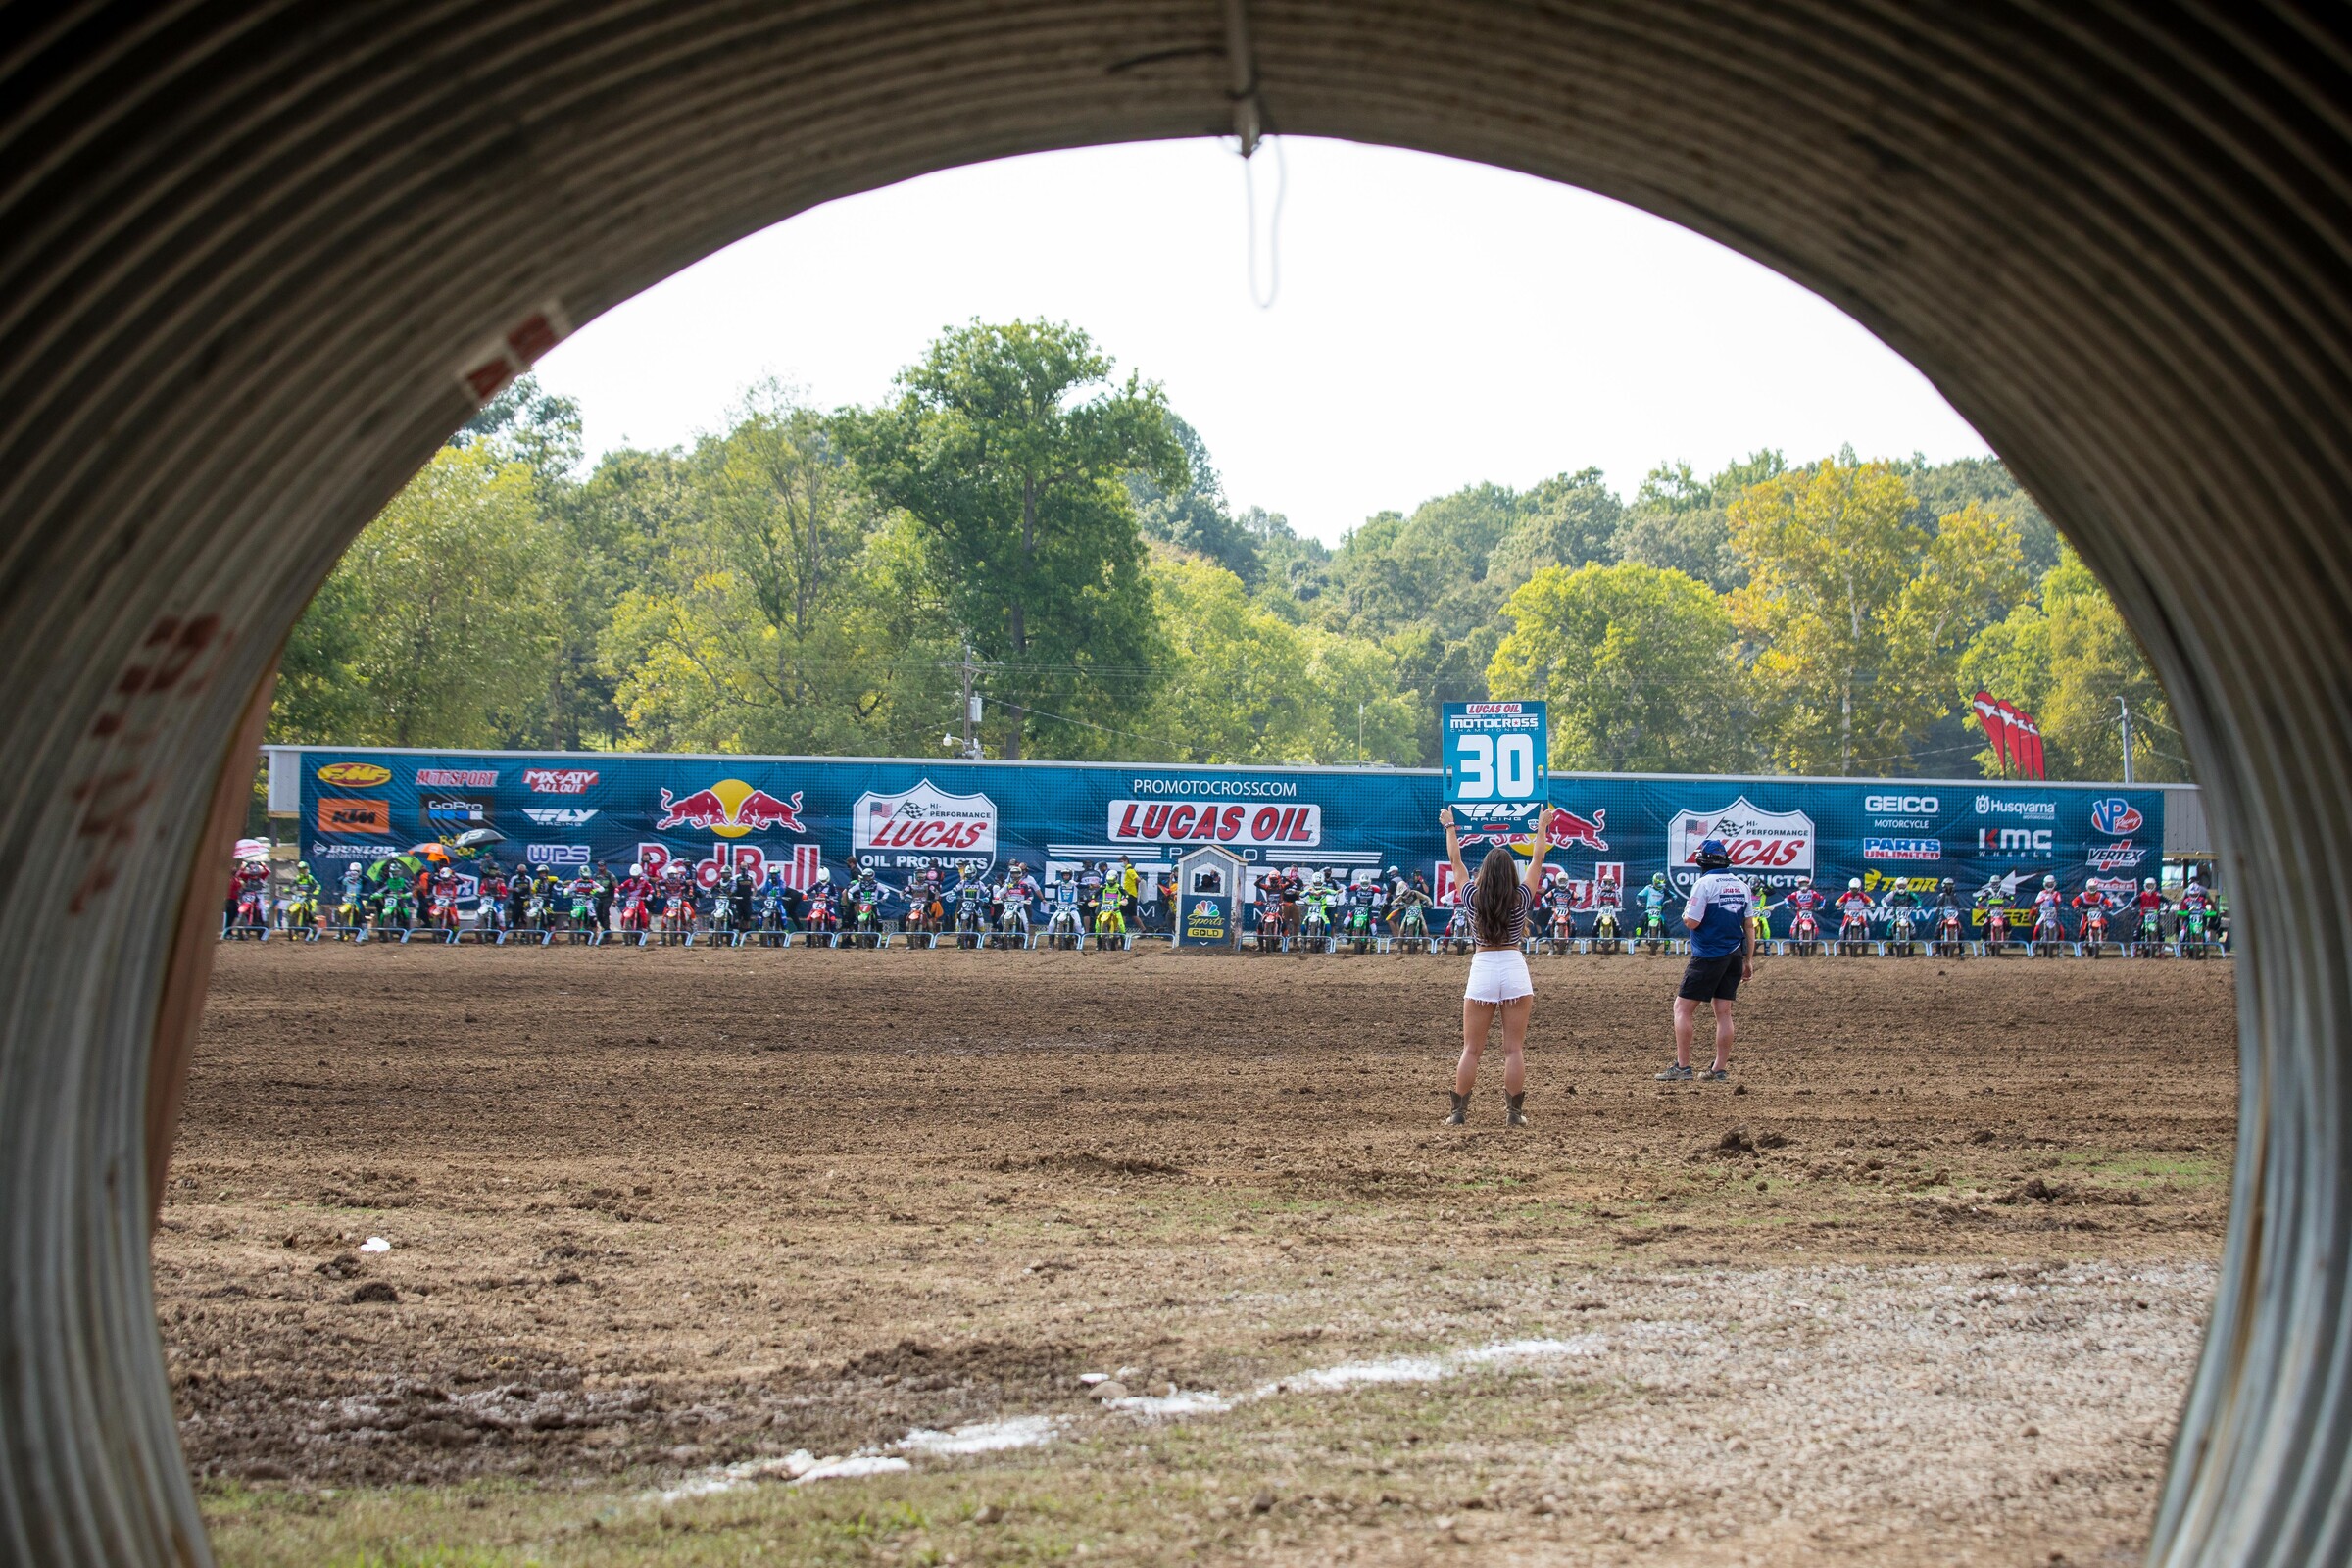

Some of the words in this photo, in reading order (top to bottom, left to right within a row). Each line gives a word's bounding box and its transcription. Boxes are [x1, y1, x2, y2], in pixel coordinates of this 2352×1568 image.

[1469, 704, 1501, 714] LUCAS
[1502, 704, 1521, 714] OIL
[1450, 717, 1539, 729] MOTOCROSS
[1456, 733, 1535, 799] 30
[318, 766, 391, 781] FMF
[532, 783, 559, 793] ALL
[559, 783, 585, 793] OUT
[1134, 778, 1298, 797] PROMOTOCROSS.COM
[428, 800, 484, 811] GoPro
[1450, 803, 1542, 817] FLY
[1865, 795, 1939, 813] GEICO
[1990, 799, 2057, 815] Husqvarna
[331, 808, 377, 824] KTM
[520, 808, 600, 822] FLY
[929, 810, 992, 819] PERFORMANCE
[2092, 798, 2129, 834] VP
[1115, 803, 1246, 842] LUCAS
[1250, 806, 1314, 842] OIL
[1874, 819, 1930, 829] MOTORCYCLE
[869, 820, 988, 849] LUCAS
[327, 844, 397, 855] DUNLOP
[1864, 837, 1940, 852] PARTS
[527, 844, 591, 864] WPS
[1169, 847, 1258, 861] PO
[1865, 850, 1940, 859] UNLIMITED
[2088, 849, 2143, 861] VERTEX
[861, 855, 891, 868] OIL
[1881, 877, 1939, 893] TOR
[1186, 913, 1225, 927] Sports
[1192, 928, 1220, 937] GOLD
